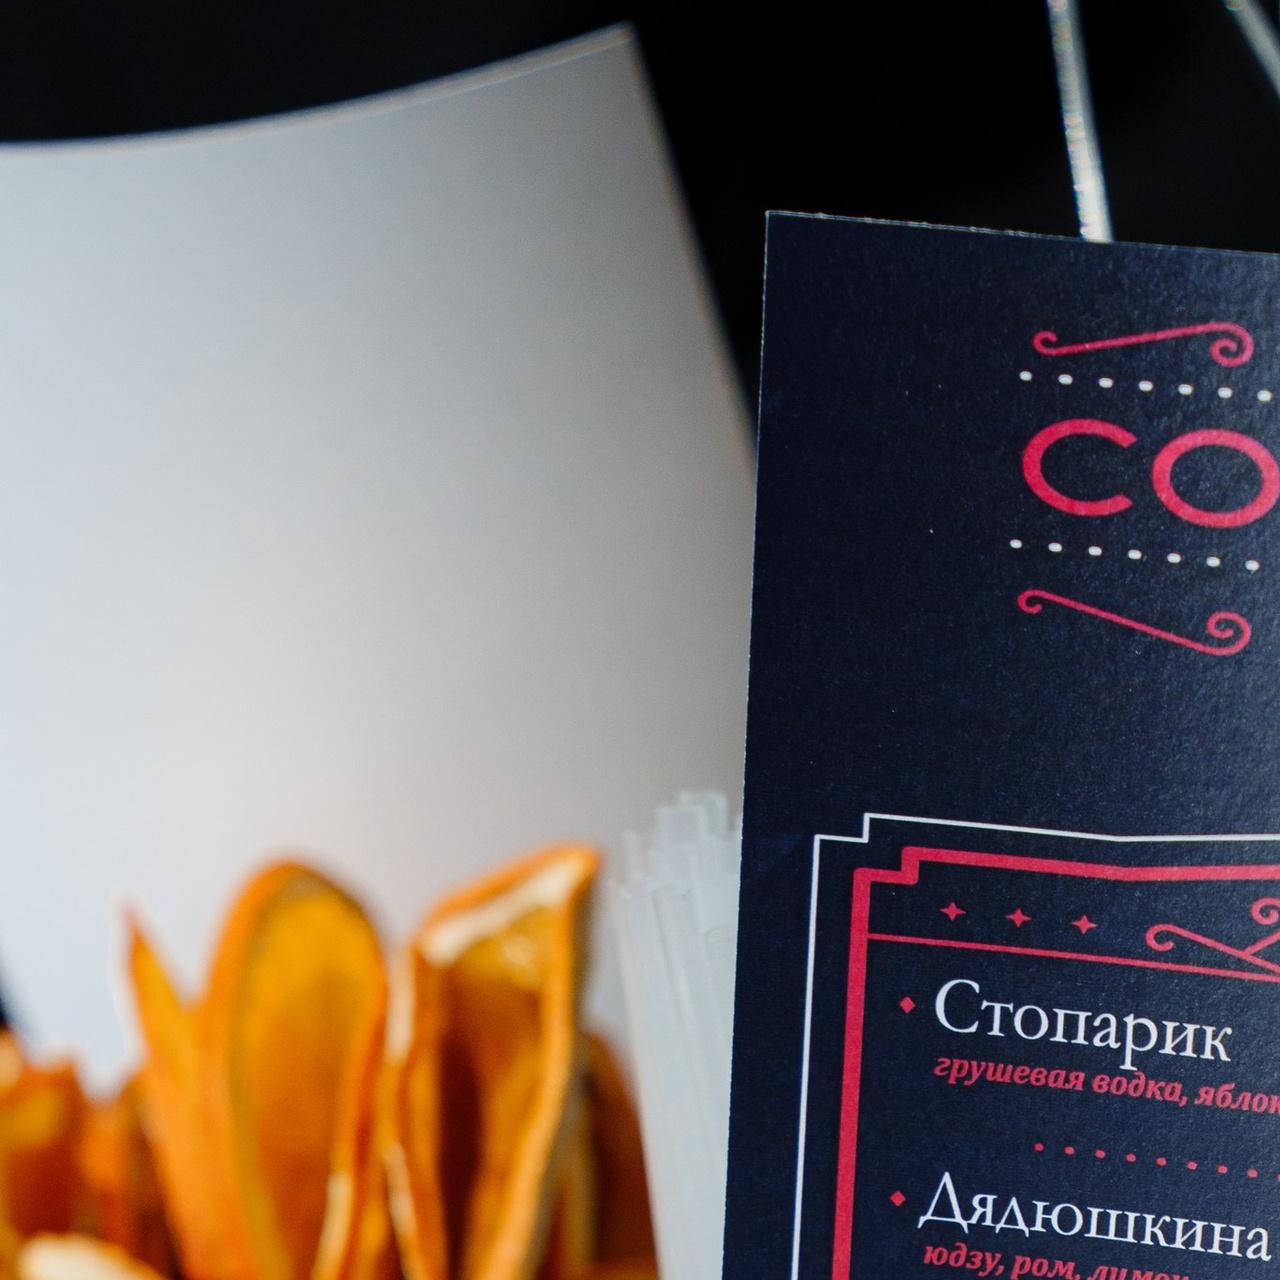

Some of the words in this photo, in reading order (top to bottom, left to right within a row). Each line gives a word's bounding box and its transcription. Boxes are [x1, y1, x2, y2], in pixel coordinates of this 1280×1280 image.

[935, 979, 1233, 1071] Стопарик
[934, 1057, 1085, 1091] грушевая
[1092, 1071, 1187, 1106] водка,
[918, 1171, 1272, 1262] Дядюшкина
[923, 1242, 1004, 1277] юдзу,
